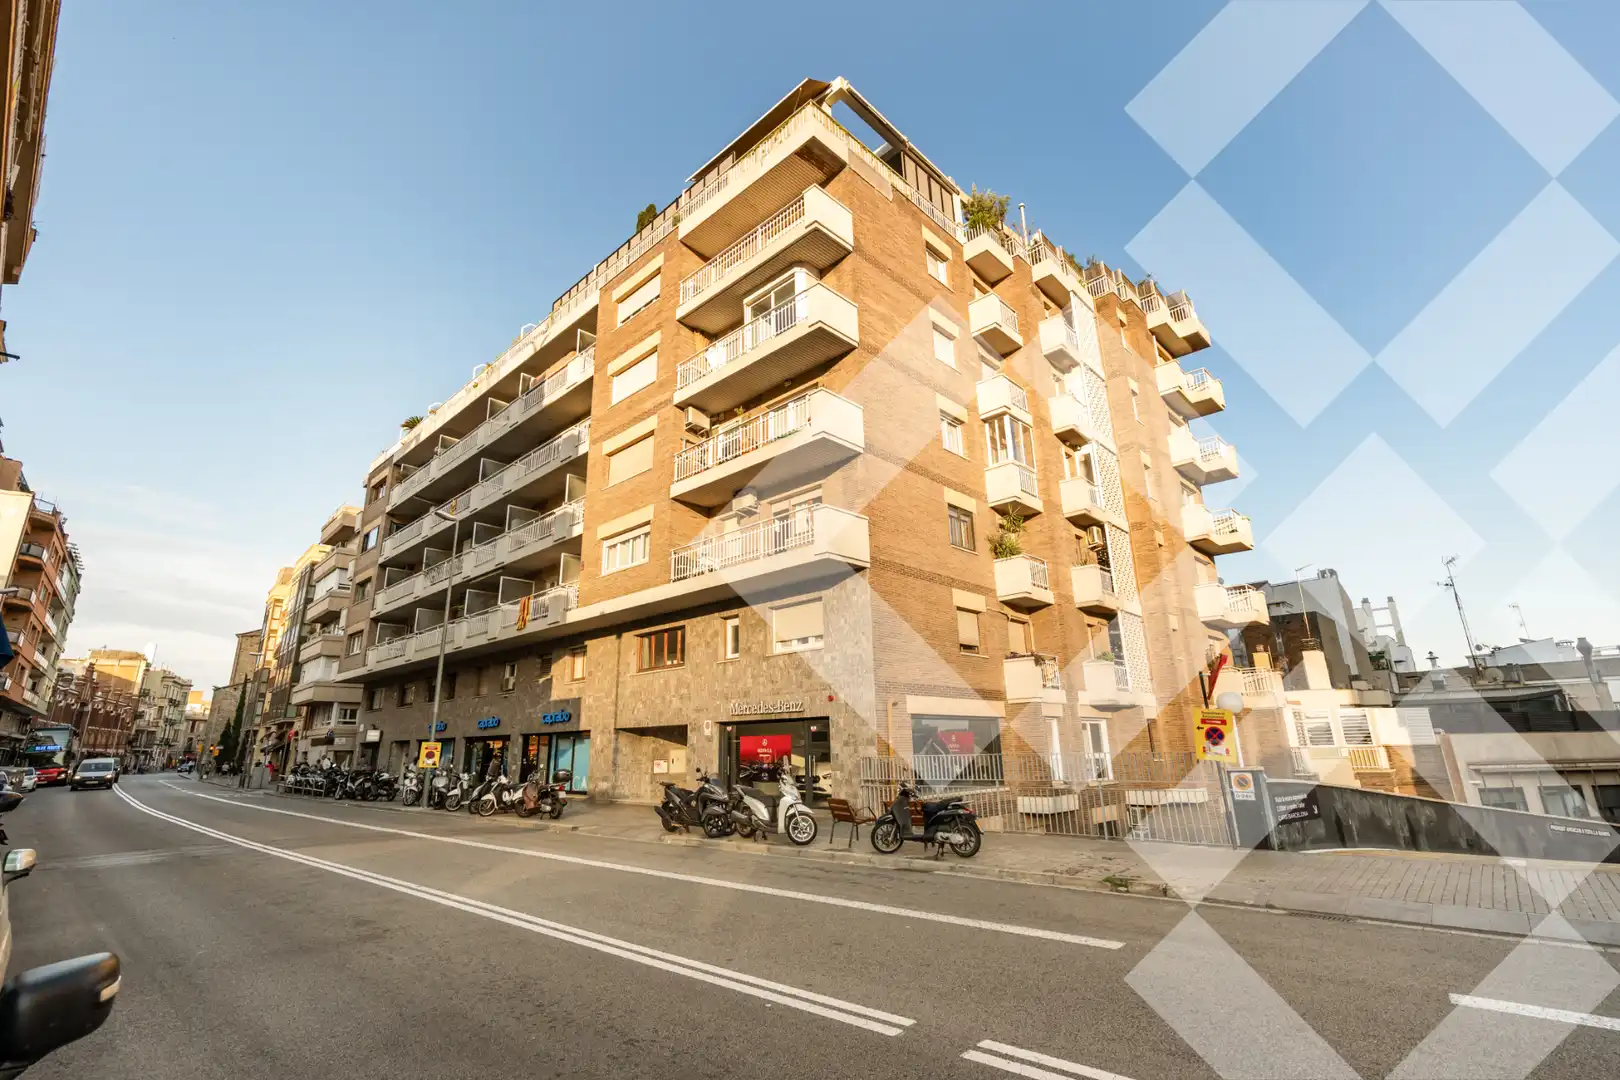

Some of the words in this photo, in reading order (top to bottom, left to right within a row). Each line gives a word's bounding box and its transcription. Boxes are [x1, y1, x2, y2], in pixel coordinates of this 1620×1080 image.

[730, 699, 804, 716] Mercedes-Benz
[477, 716, 500, 730] caprabo
[542, 709, 571, 725] caprabo
